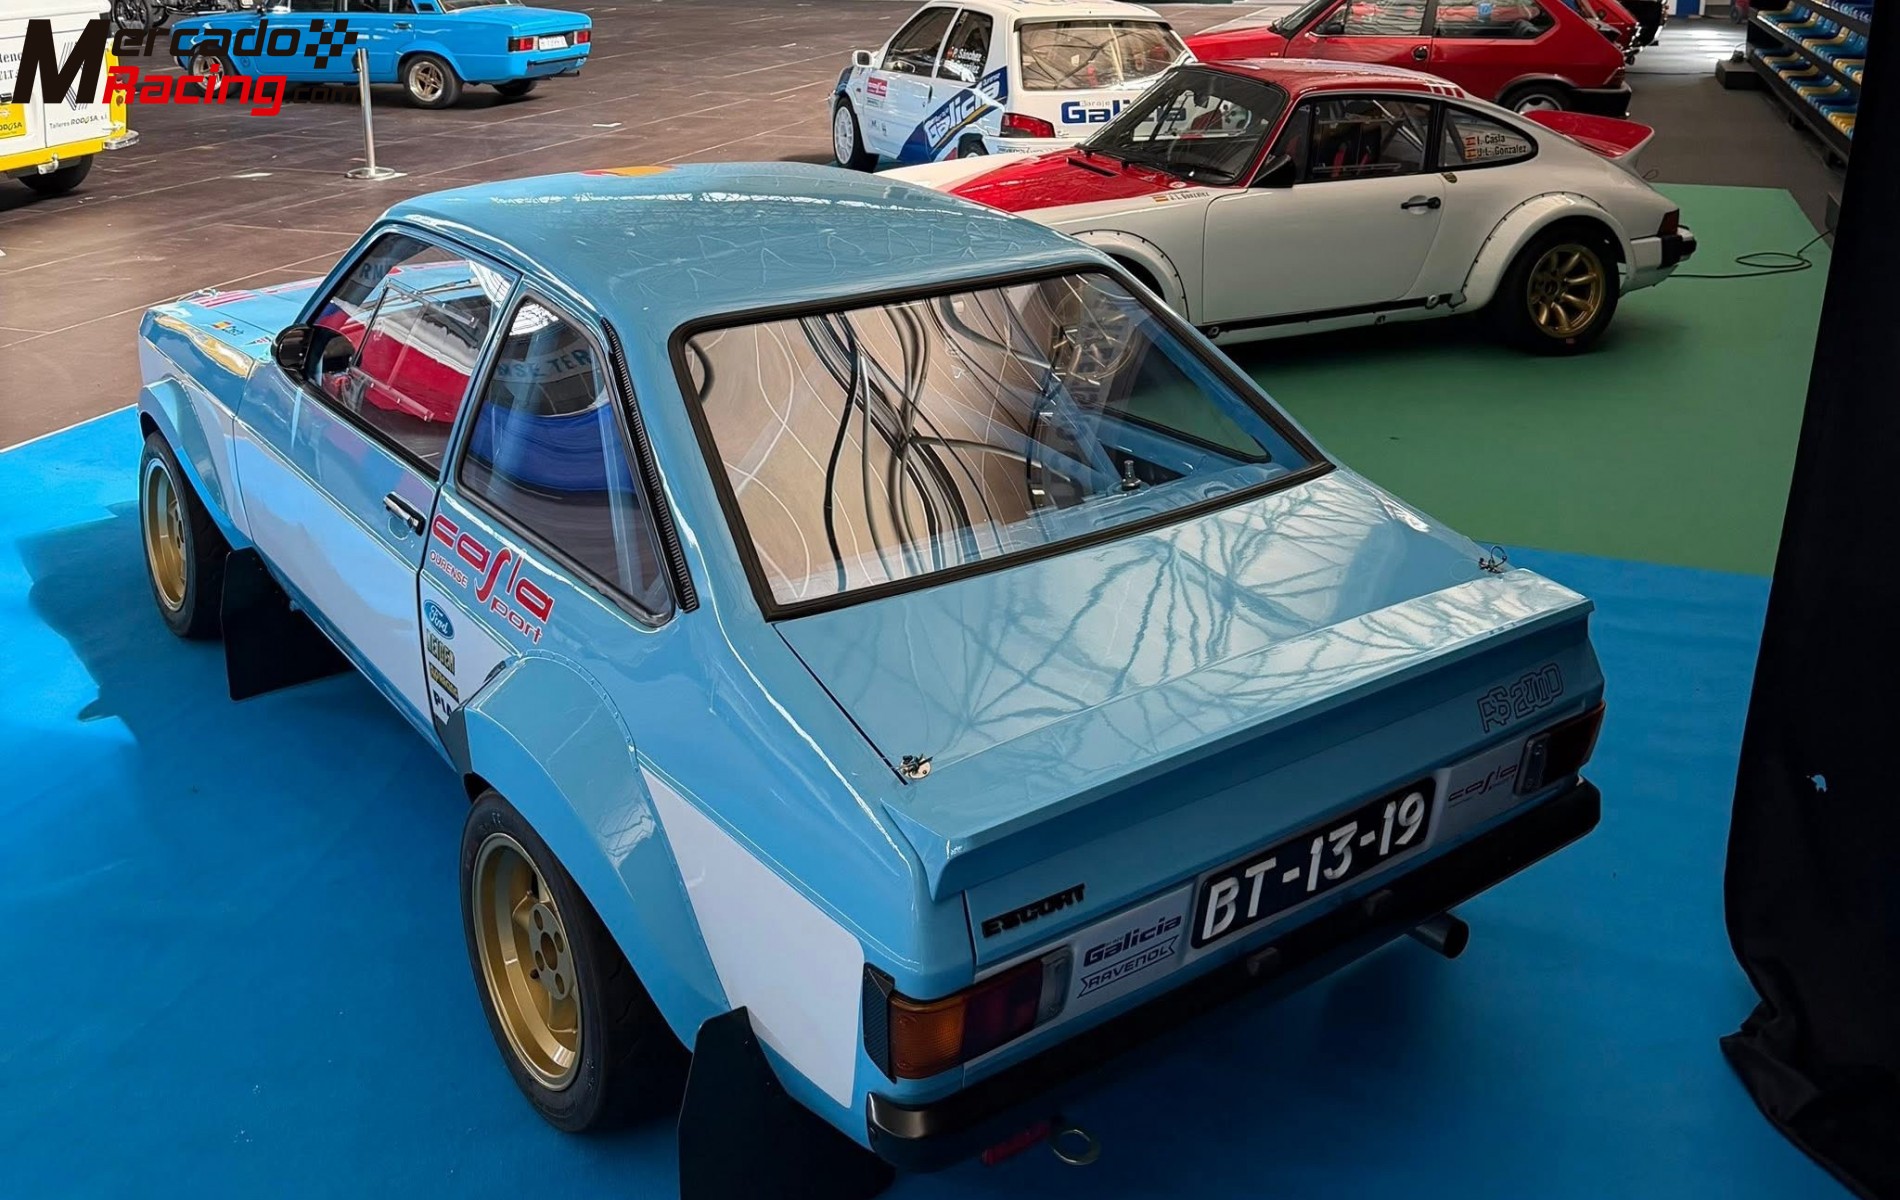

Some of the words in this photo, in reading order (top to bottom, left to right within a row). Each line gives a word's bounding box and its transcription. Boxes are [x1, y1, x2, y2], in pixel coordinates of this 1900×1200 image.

[430, 549, 469, 588] OURENSE
[429, 604, 449, 635] Ford
[1202, 791, 1426, 940] BT-13-19
[981, 882, 1086, 938] ESCORT
[1083, 915, 1183, 967] Galicia
[1087, 945, 1169, 989] RAVENOL
